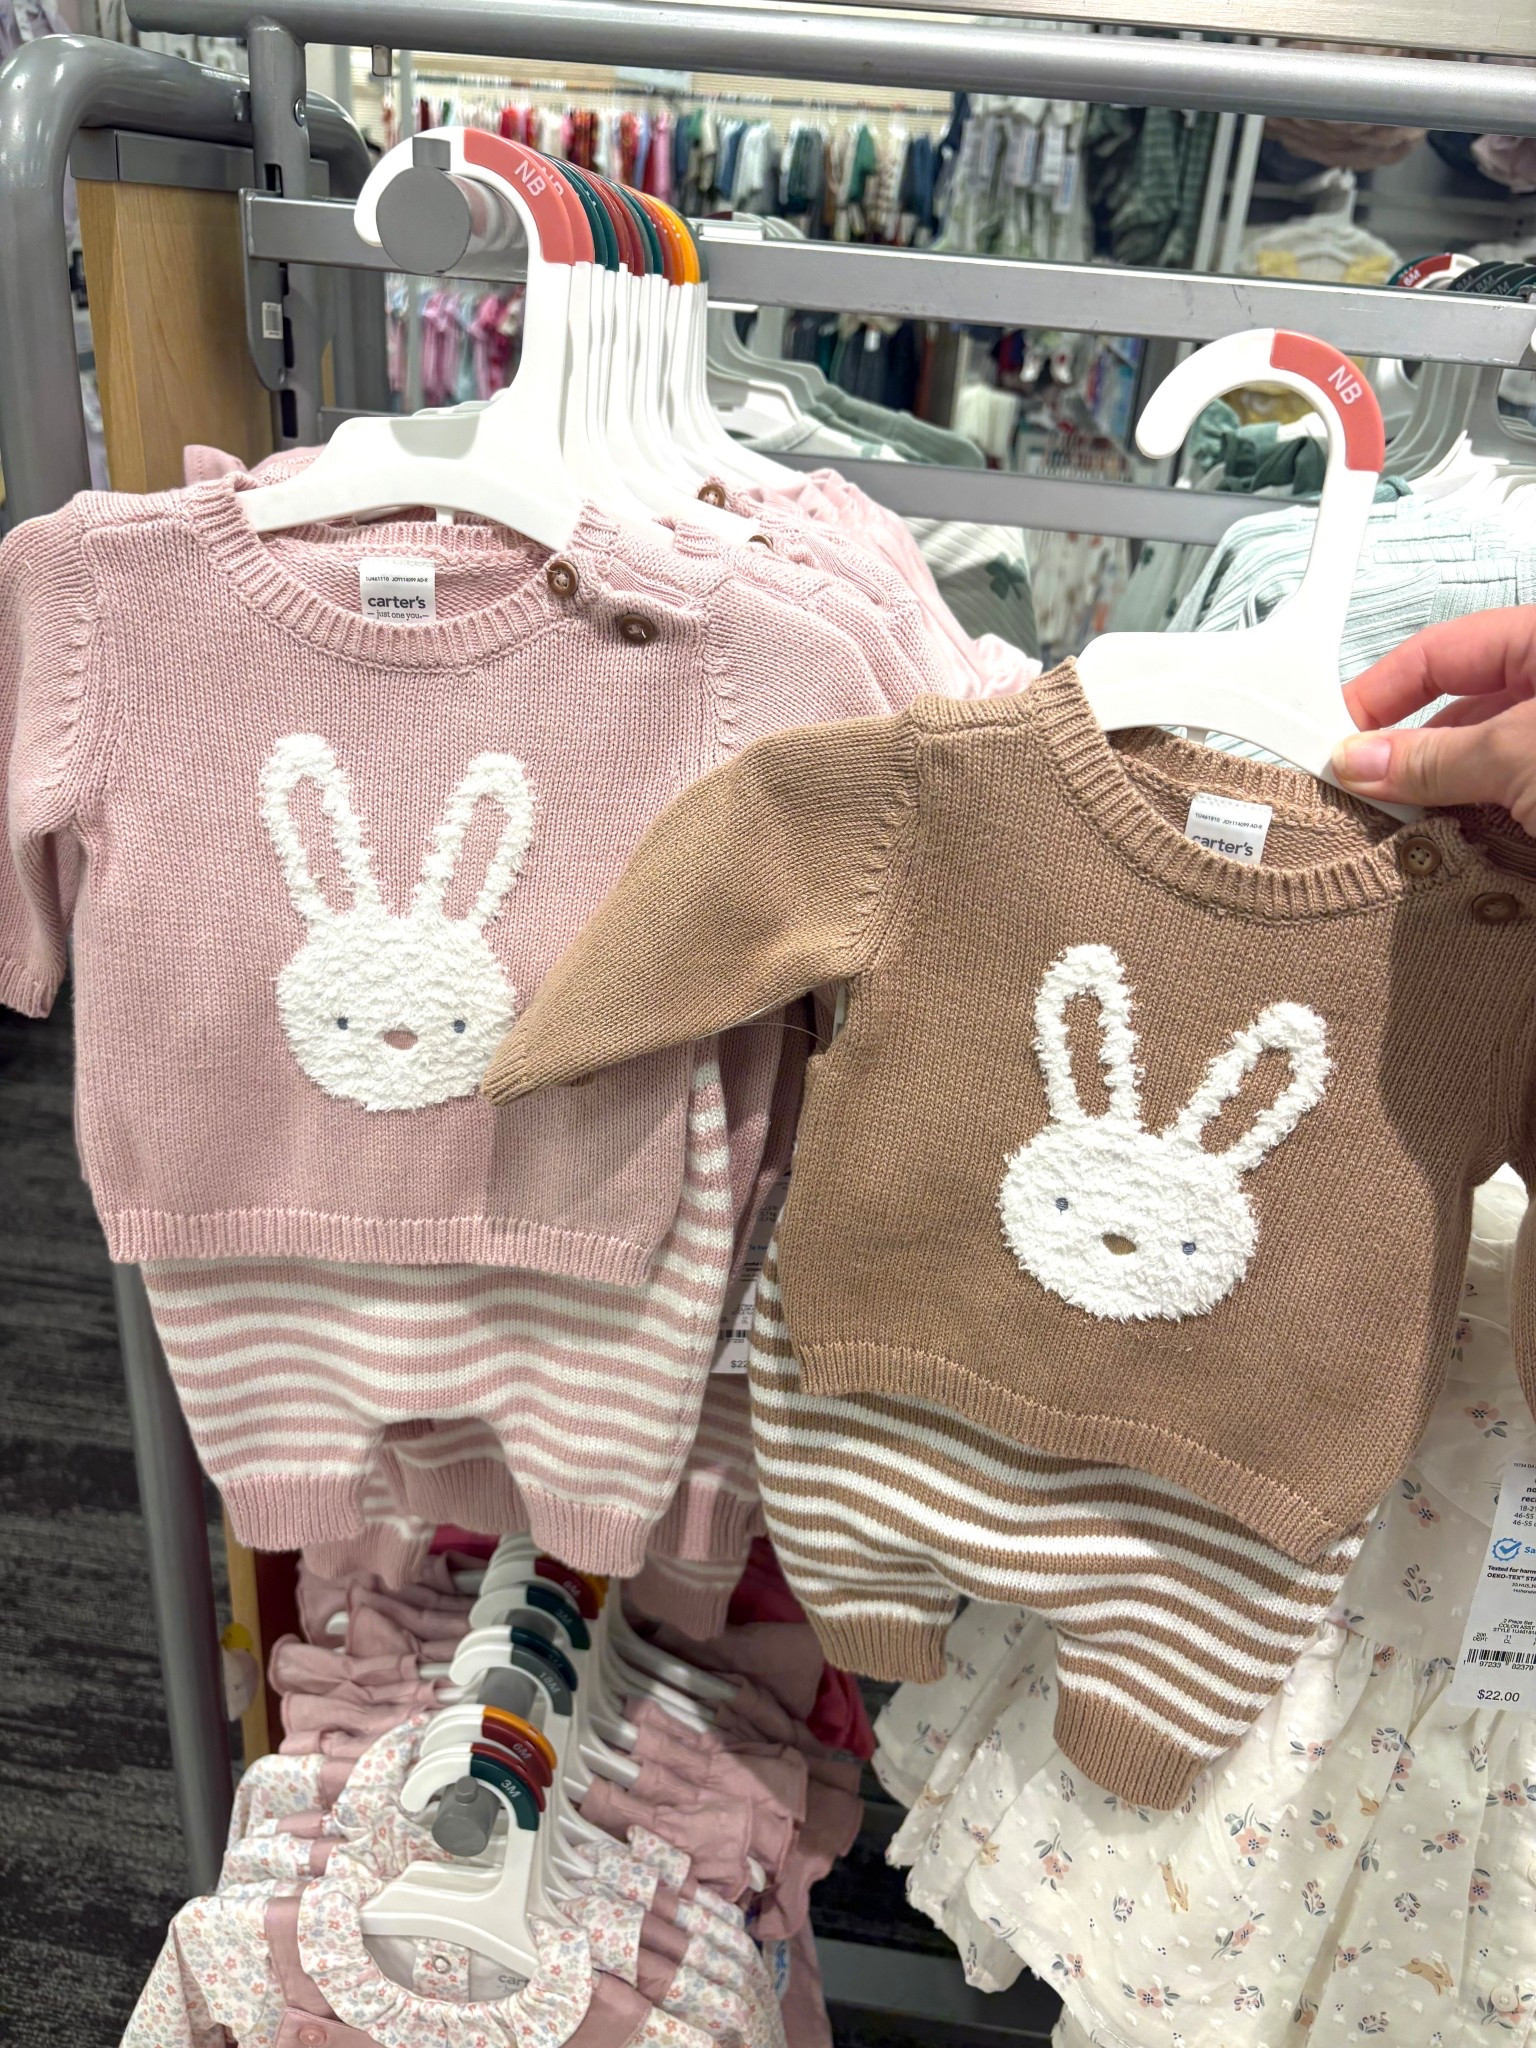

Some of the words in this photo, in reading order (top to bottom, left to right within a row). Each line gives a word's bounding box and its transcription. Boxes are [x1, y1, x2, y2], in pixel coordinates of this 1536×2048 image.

[514, 159, 547, 197] NB
[1327, 365, 1364, 405] NB
[367, 595, 426, 609] carter's
[376, 610, 390, 620] just
[1512, 1519, 1533, 1527] 46-55
[1514, 1512, 1534, 1520] 46-55
[1477, 1688, 1520, 1702] $22.00
[512, 1742, 533, 1759] 6M
[500, 1779, 522, 1798] 3M
